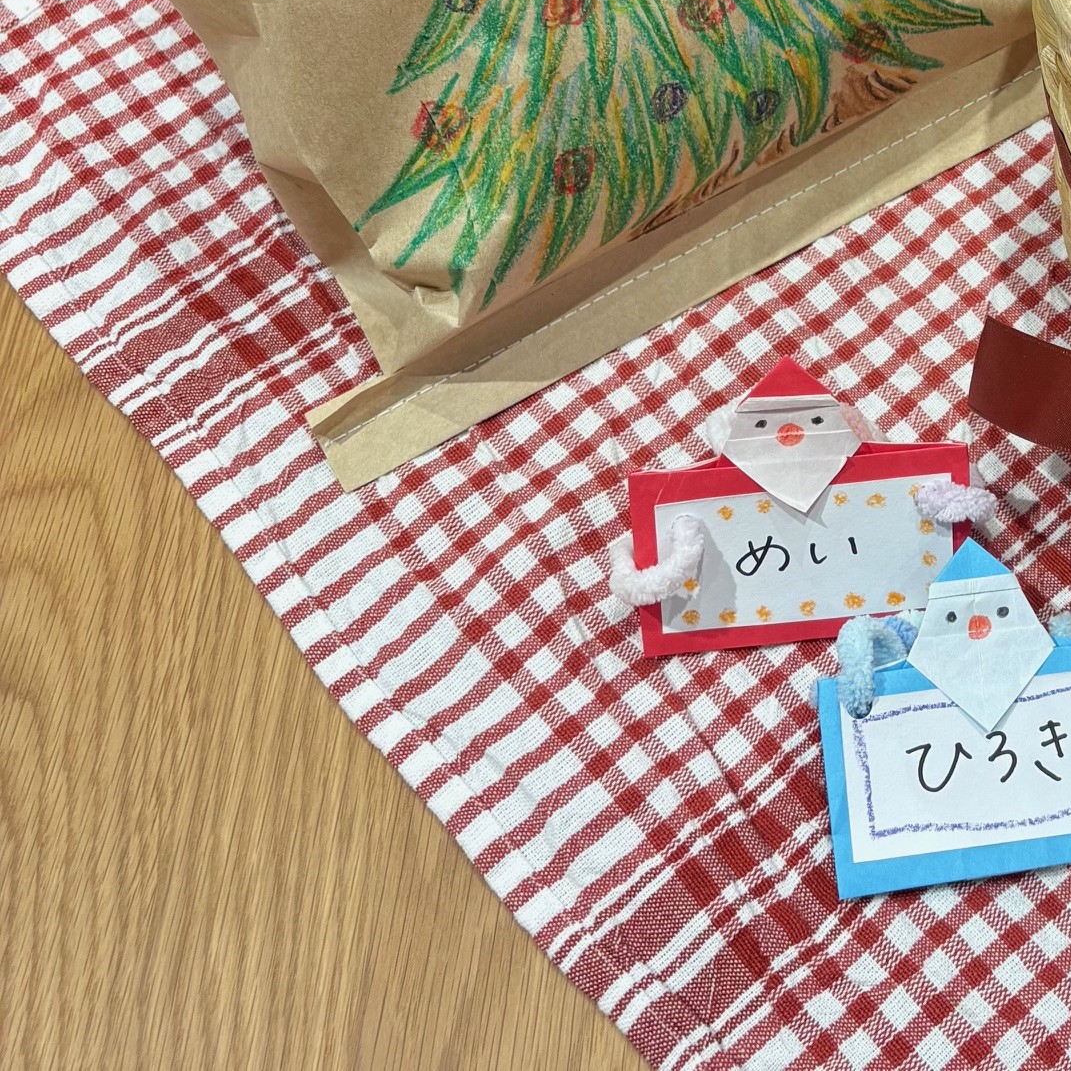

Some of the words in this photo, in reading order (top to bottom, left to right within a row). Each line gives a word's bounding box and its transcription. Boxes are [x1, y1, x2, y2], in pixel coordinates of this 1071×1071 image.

[735, 535, 858, 577] めい
[905, 720, 1068, 793] ひろき
